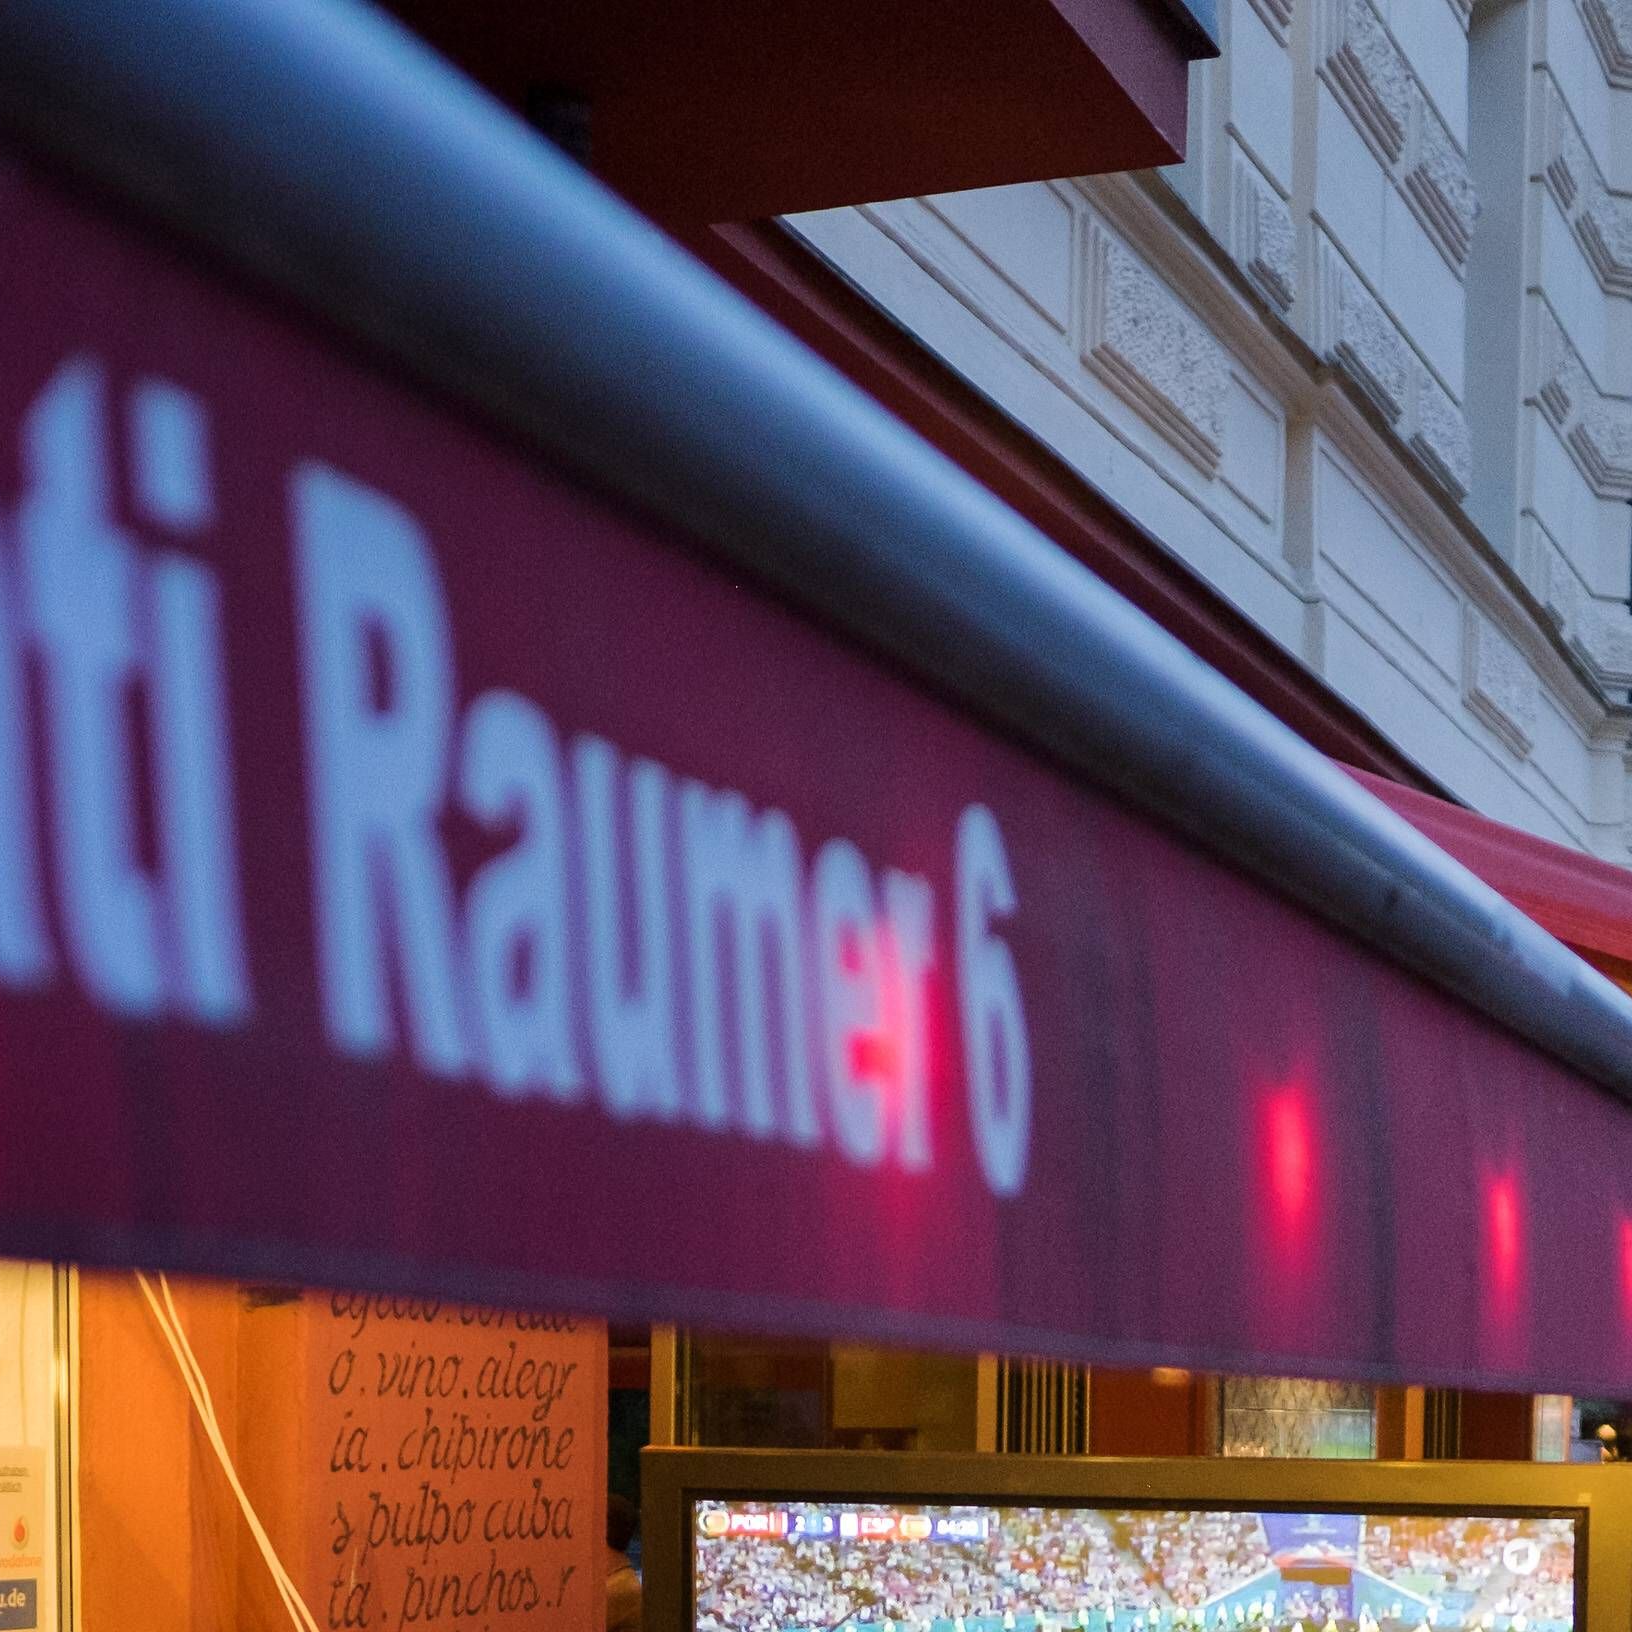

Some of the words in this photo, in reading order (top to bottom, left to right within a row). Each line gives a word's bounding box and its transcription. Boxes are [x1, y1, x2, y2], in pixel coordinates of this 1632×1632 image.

[292, 460, 936, 1168] Raumer
[956, 804, 1028, 1194] 6
[475, 1340, 578, 1422] alegr
[396, 1406, 575, 1485] chipirone
[361, 1480, 476, 1566] pulpo
[483, 1477, 573, 1543] cuba
